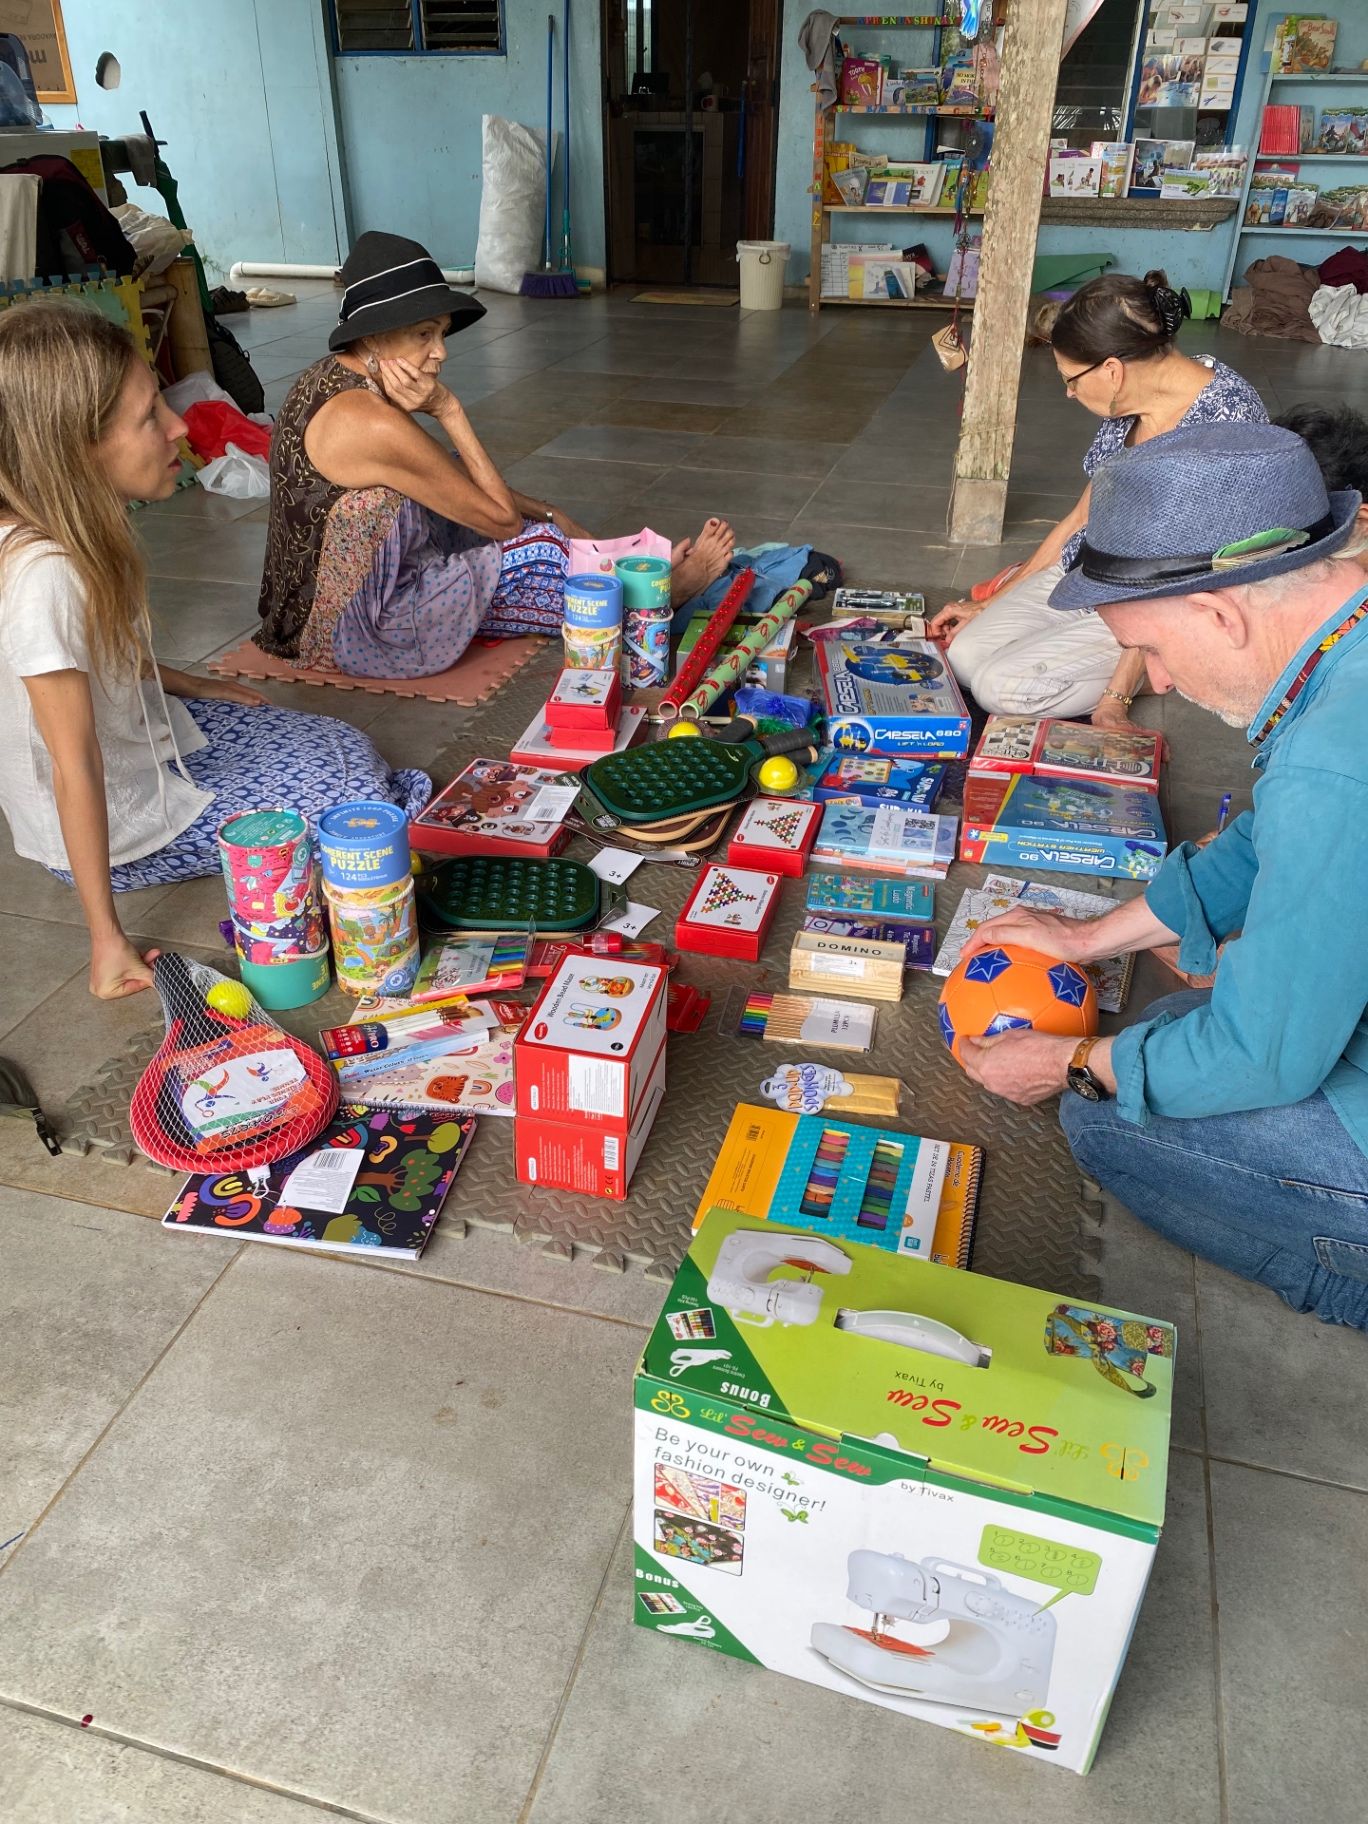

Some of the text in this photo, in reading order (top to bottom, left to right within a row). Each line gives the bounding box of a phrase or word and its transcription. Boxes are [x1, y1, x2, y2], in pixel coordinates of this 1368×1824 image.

[875, 729, 936, 740] CAPSELA
[1045, 751, 1151, 776] CHESS
[1050, 821, 1159, 839] CAPSELA
[363, 846, 394, 860] SCENE
[1019, 850, 1115, 868] CAPSELA 90
[330, 857, 381, 871] PUZZLE
[340, 872, 357, 881] 124
[608, 870, 622, 879] 3+
[622, 922, 637, 931] 3+
[817, 942, 882, 956] DOMINO
[800, 1064, 819, 1112] SPONGES
[895, 1370, 944, 1392] by Tivax
[720, 1381, 771, 1408] Bonus
[887, 1389, 961, 1427] Sew
[961, 1414, 977, 1431] &
[982, 1415, 1059, 1454] Sew
[655, 1427, 775, 1477] Be your own
[724, 1414, 788, 1448] Sew
[792, 1439, 806, 1451] &
[805, 1443, 872, 1477] Sew
[654, 1446, 827, 1512] fashion designer!
[900, 1481, 955, 1503] by Tivax
[635, 1568, 680, 1588] Bonus
